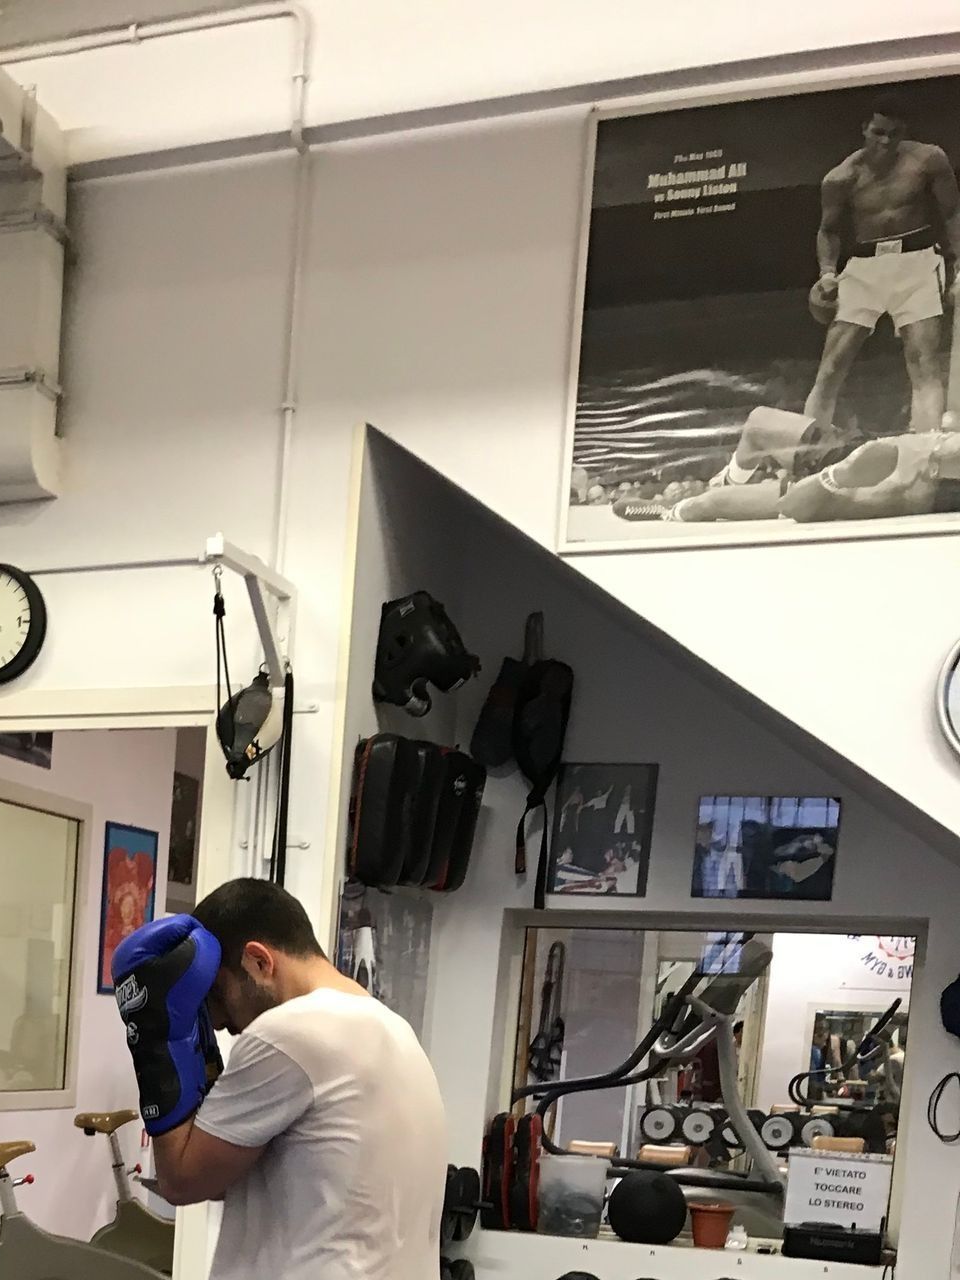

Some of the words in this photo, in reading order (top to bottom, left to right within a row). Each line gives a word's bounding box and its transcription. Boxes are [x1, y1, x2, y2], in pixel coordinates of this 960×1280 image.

[647, 164, 726, 189] Muhammad
[727, 162, 747, 179] Ali
[666, 187, 702, 201] Sonny
[702, 182, 737, 197] Liston
[16, 616, 22, 628] 1
[825, 1168, 867, 1180] VIETATO
[814, 1182, 863, 1195] TOCCARE
[808, 1198, 822, 1207] LO
[823, 1199, 865, 1212] STEREO
